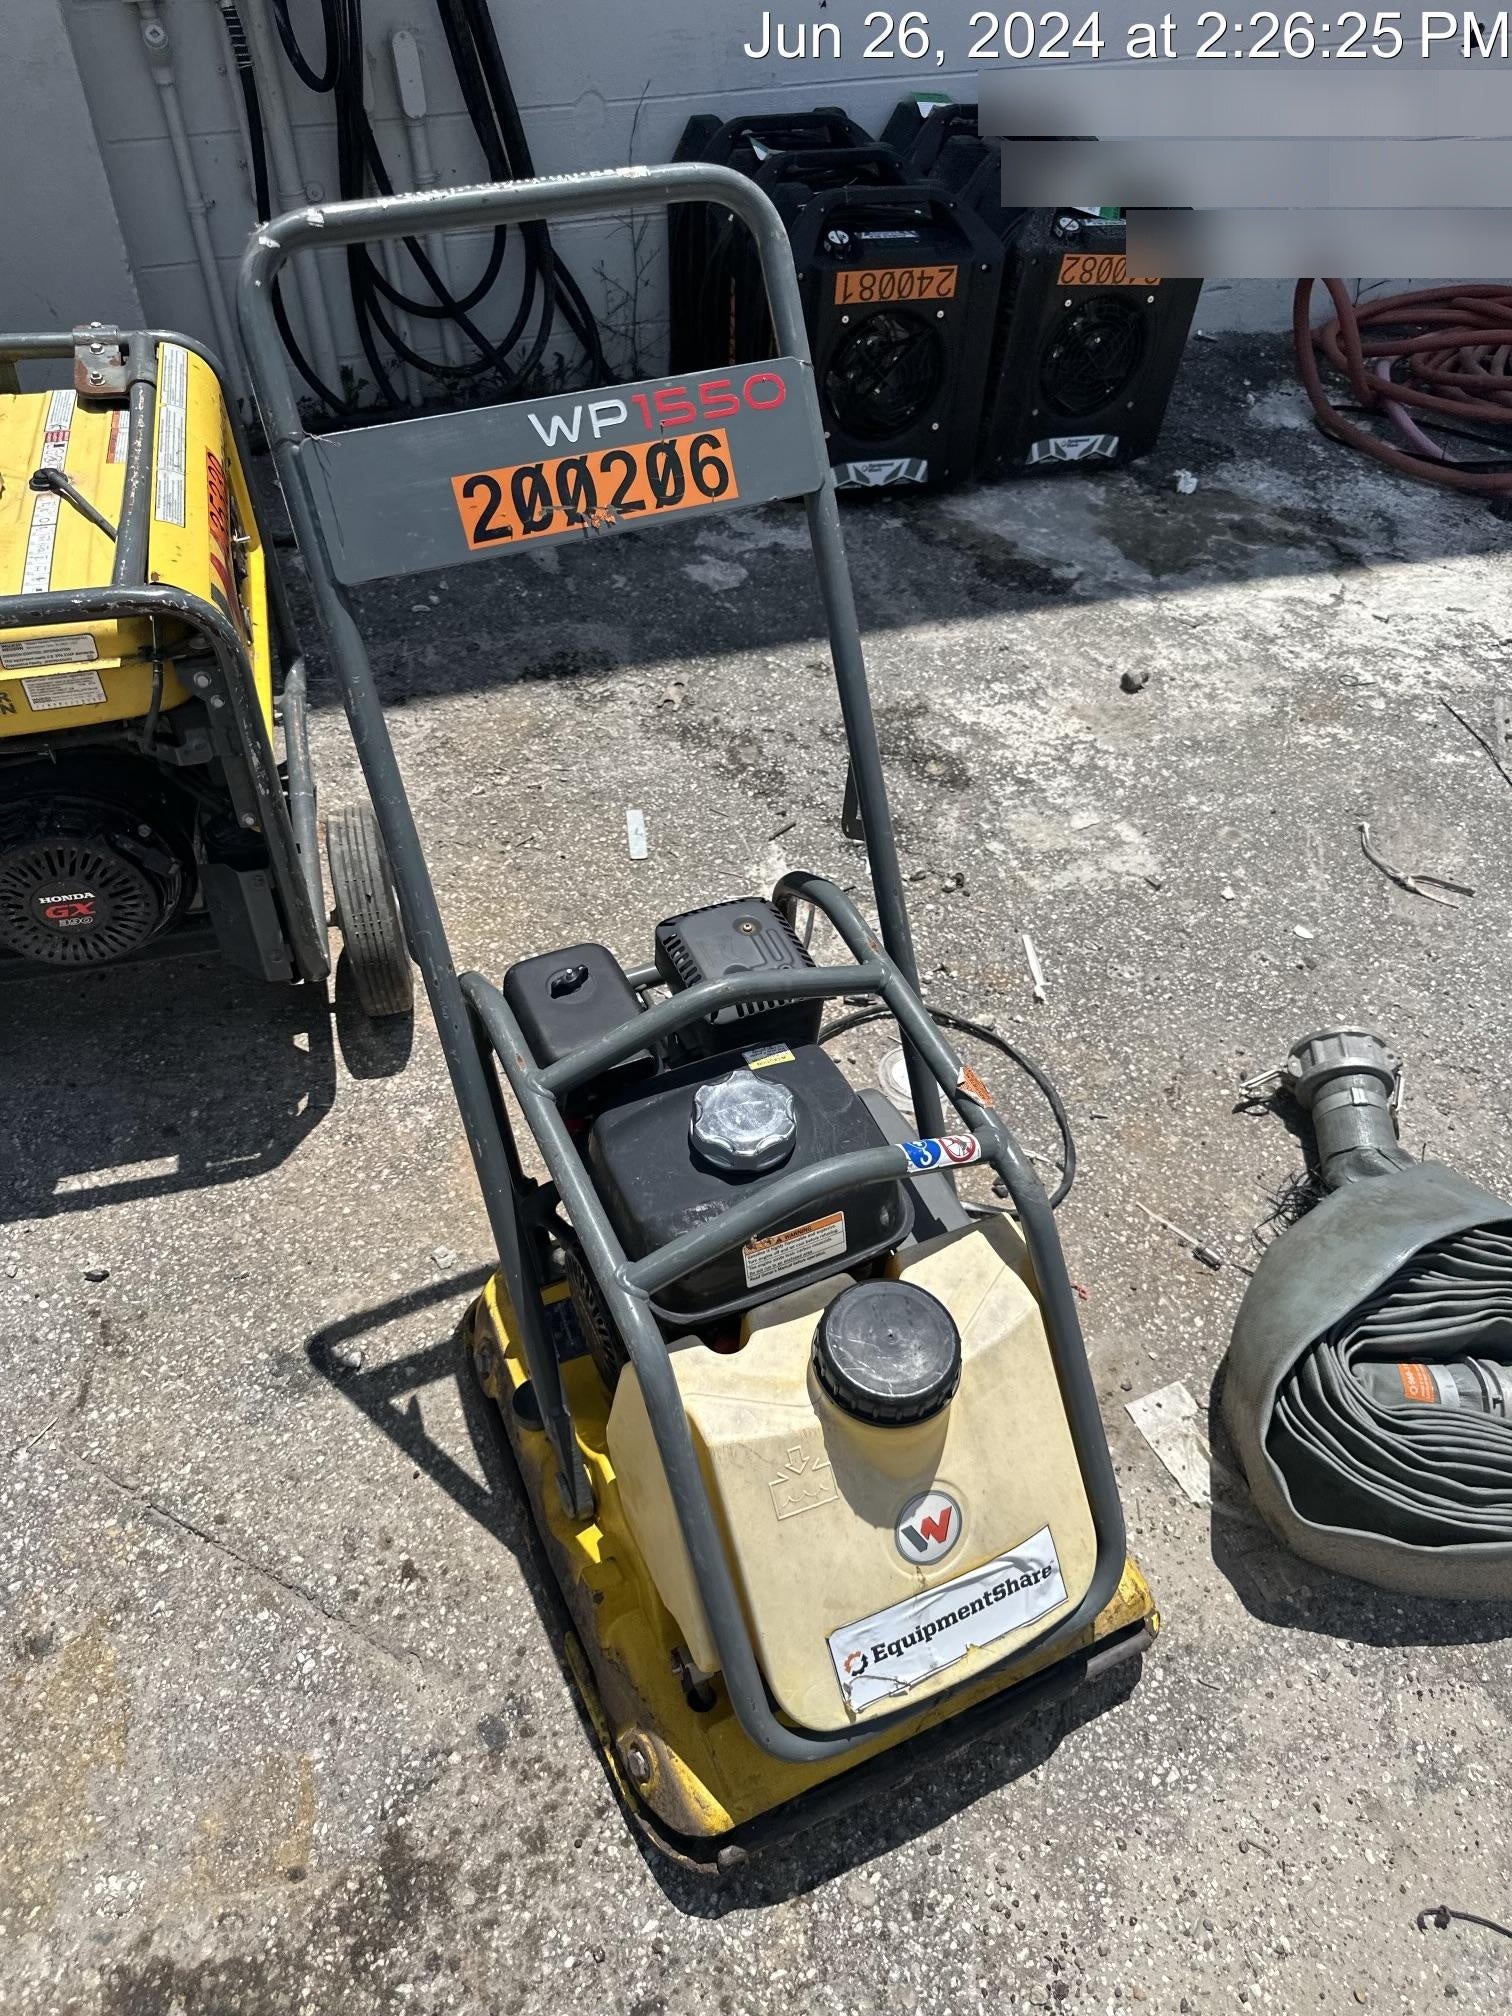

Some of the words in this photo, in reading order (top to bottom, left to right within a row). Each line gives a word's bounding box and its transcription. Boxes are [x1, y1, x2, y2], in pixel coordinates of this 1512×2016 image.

[842, 268, 956, 302] 240081
[1060, 257, 1159, 284] 0082
[527, 372, 787, 447] WP1550
[462, 433, 731, 544] 200206
[38, 892, 96, 904] HONDA
[46, 901, 97, 919] GX
[784, 1225, 811, 1239] WARNING
[871, 1564, 1053, 1664] EquipmentShare
